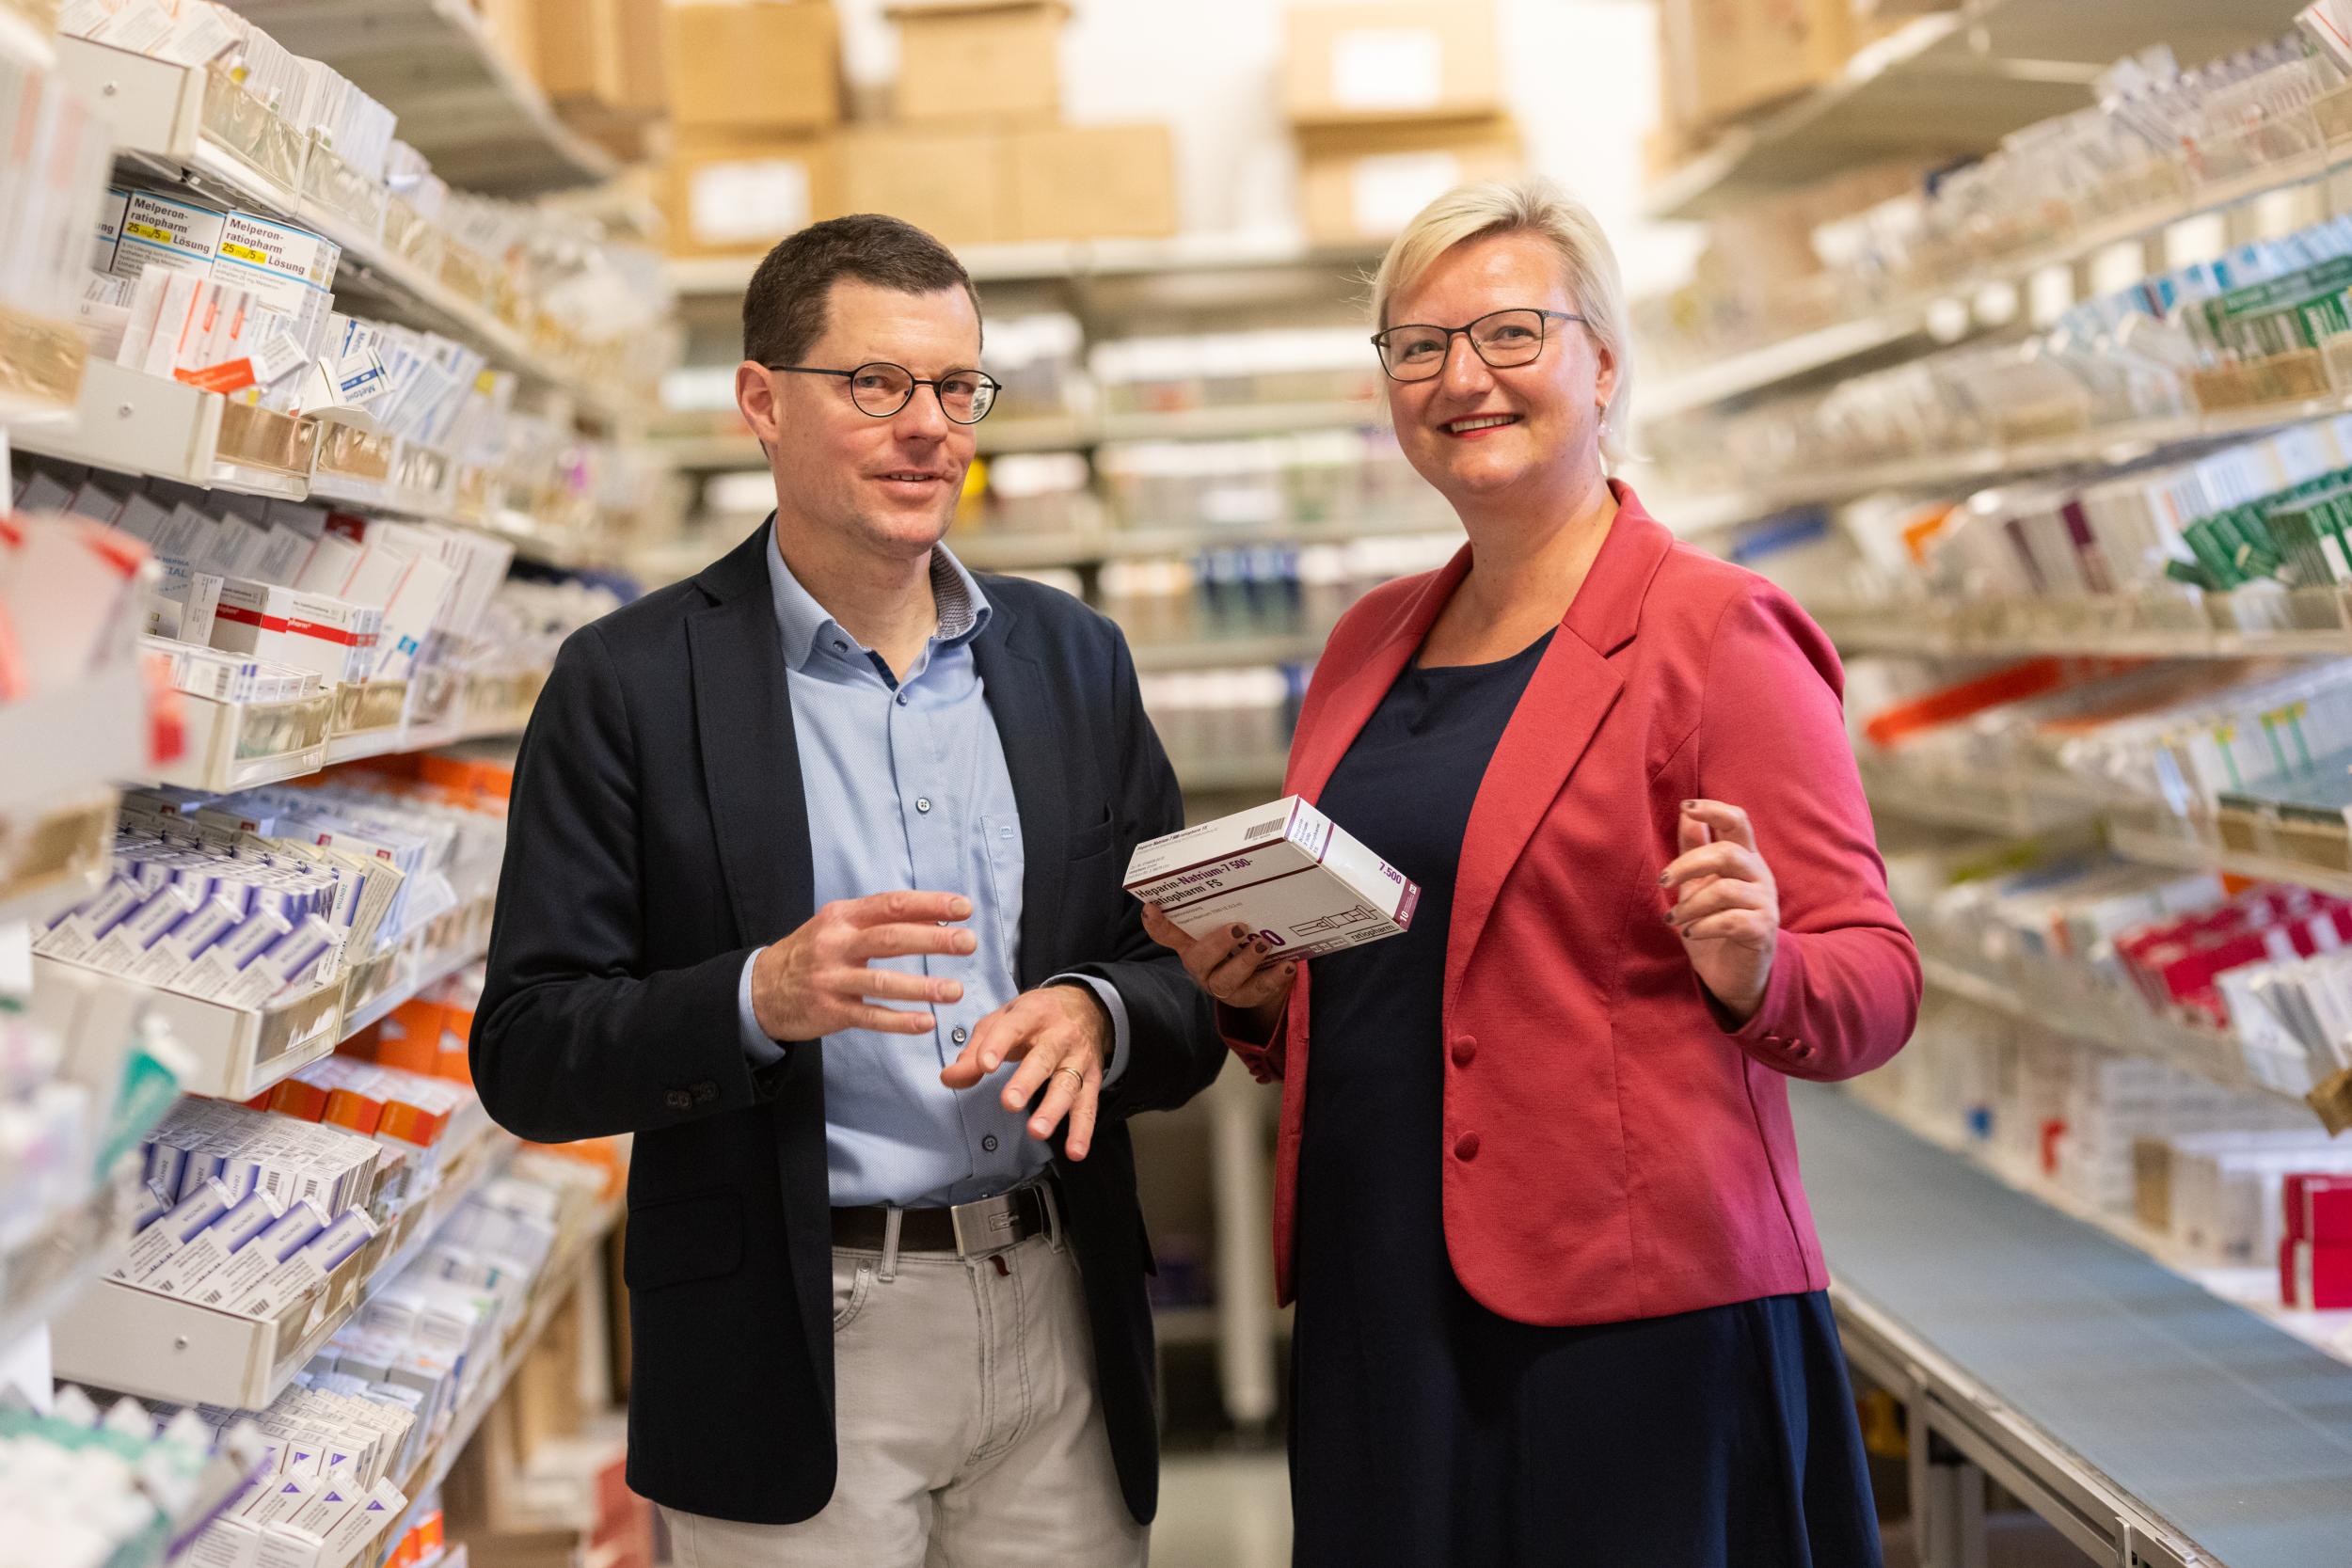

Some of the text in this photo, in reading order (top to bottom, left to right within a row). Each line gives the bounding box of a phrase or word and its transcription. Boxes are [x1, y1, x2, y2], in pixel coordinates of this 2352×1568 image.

[134, 198, 188, 220] Melperon-
[130, 212, 188, 233] ratiopharm
[230, 218, 284, 241] Melperon-
[127, 222, 139, 233] 25
[173, 234, 210, 254] Lösung
[226, 231, 282, 254] ratiopharm
[222, 243, 234, 253] 25
[268, 256, 305, 276] Lösung
[1379, 861, 1402, 884] 7.500
[1207, 879, 1223, 890] FS
[1400, 911, 1409, 923] 10
[1351, 925, 1394, 941] ratiopharm
